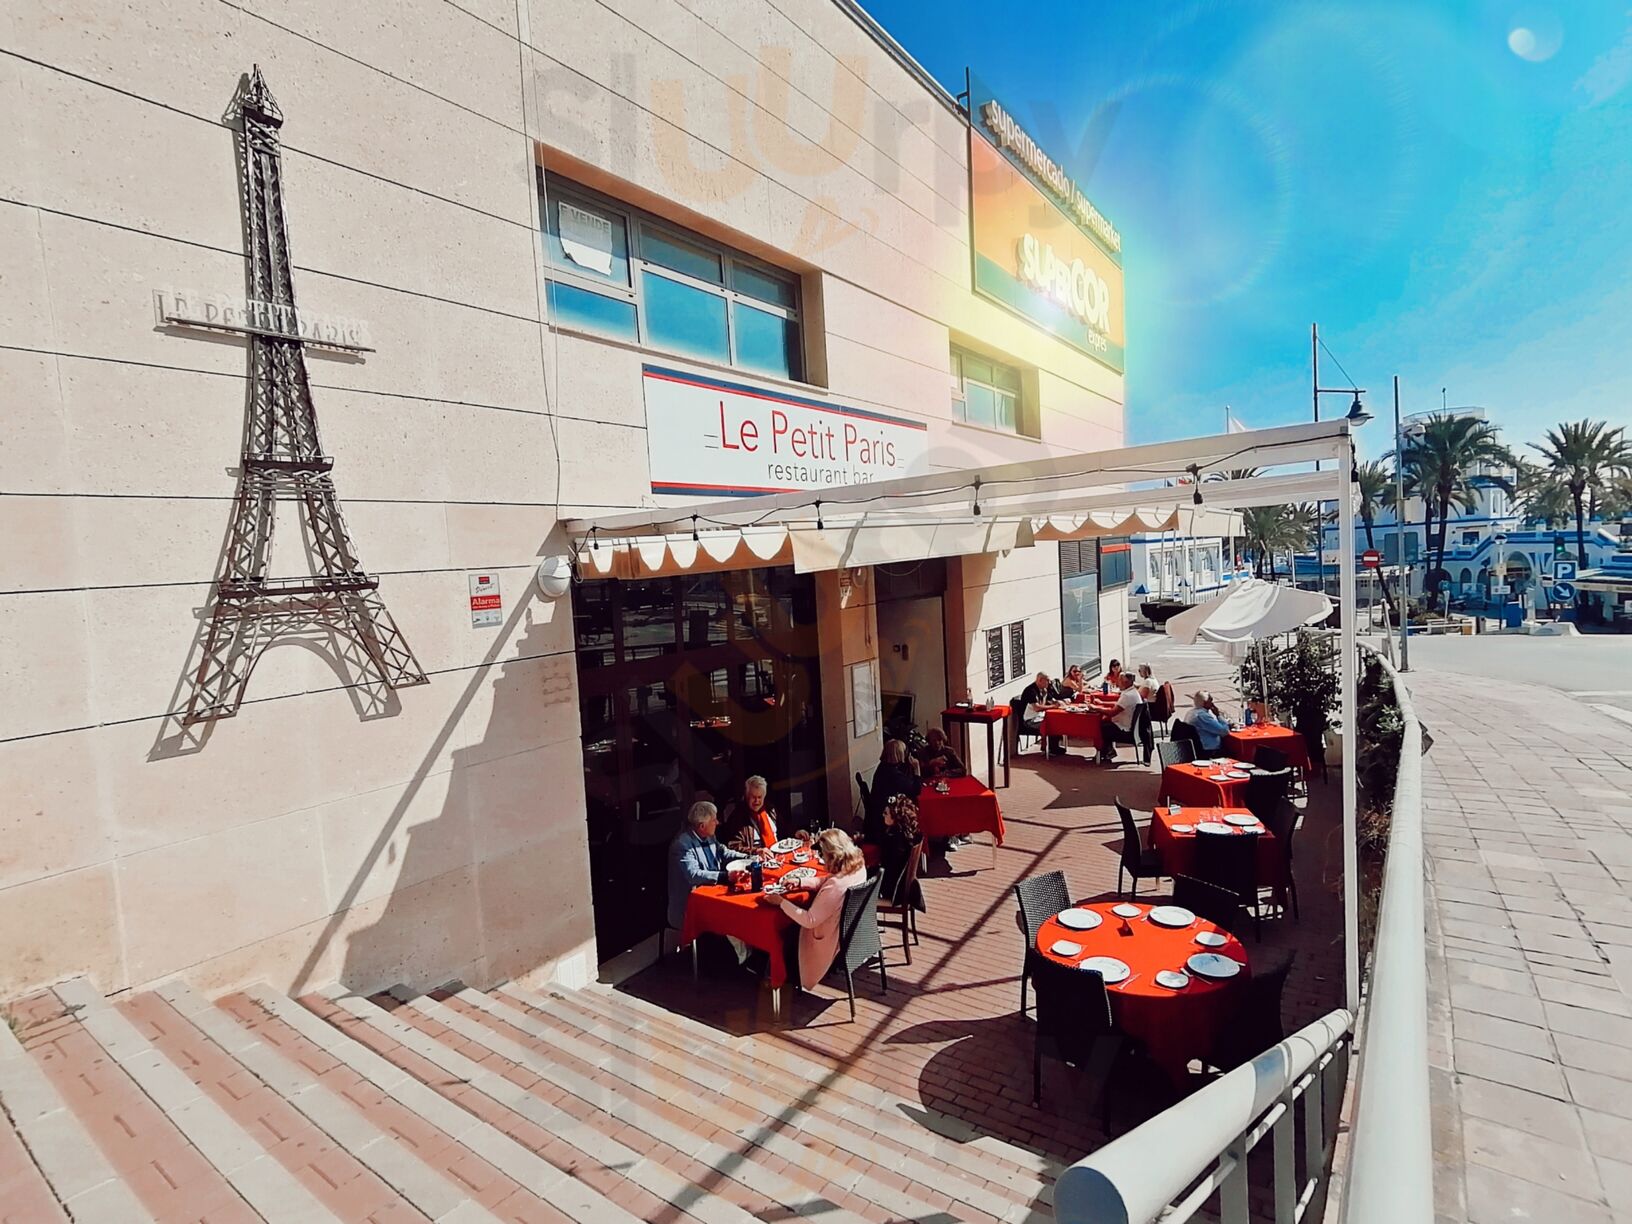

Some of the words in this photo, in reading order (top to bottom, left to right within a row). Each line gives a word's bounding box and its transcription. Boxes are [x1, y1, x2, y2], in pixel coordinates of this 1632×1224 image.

[987, 99, 1069, 199] supermercado
[1076, 190, 1121, 252] supermarket
[719, 400, 759, 452] Le
[771, 410, 836, 462] Petit
[844, 423, 896, 468] Paris
[767, 462, 847, 485] restaurant
[853, 464, 875, 485] bar
[1556, 563, 1573, 579] P
[472, 597, 500, 605] Alarma
